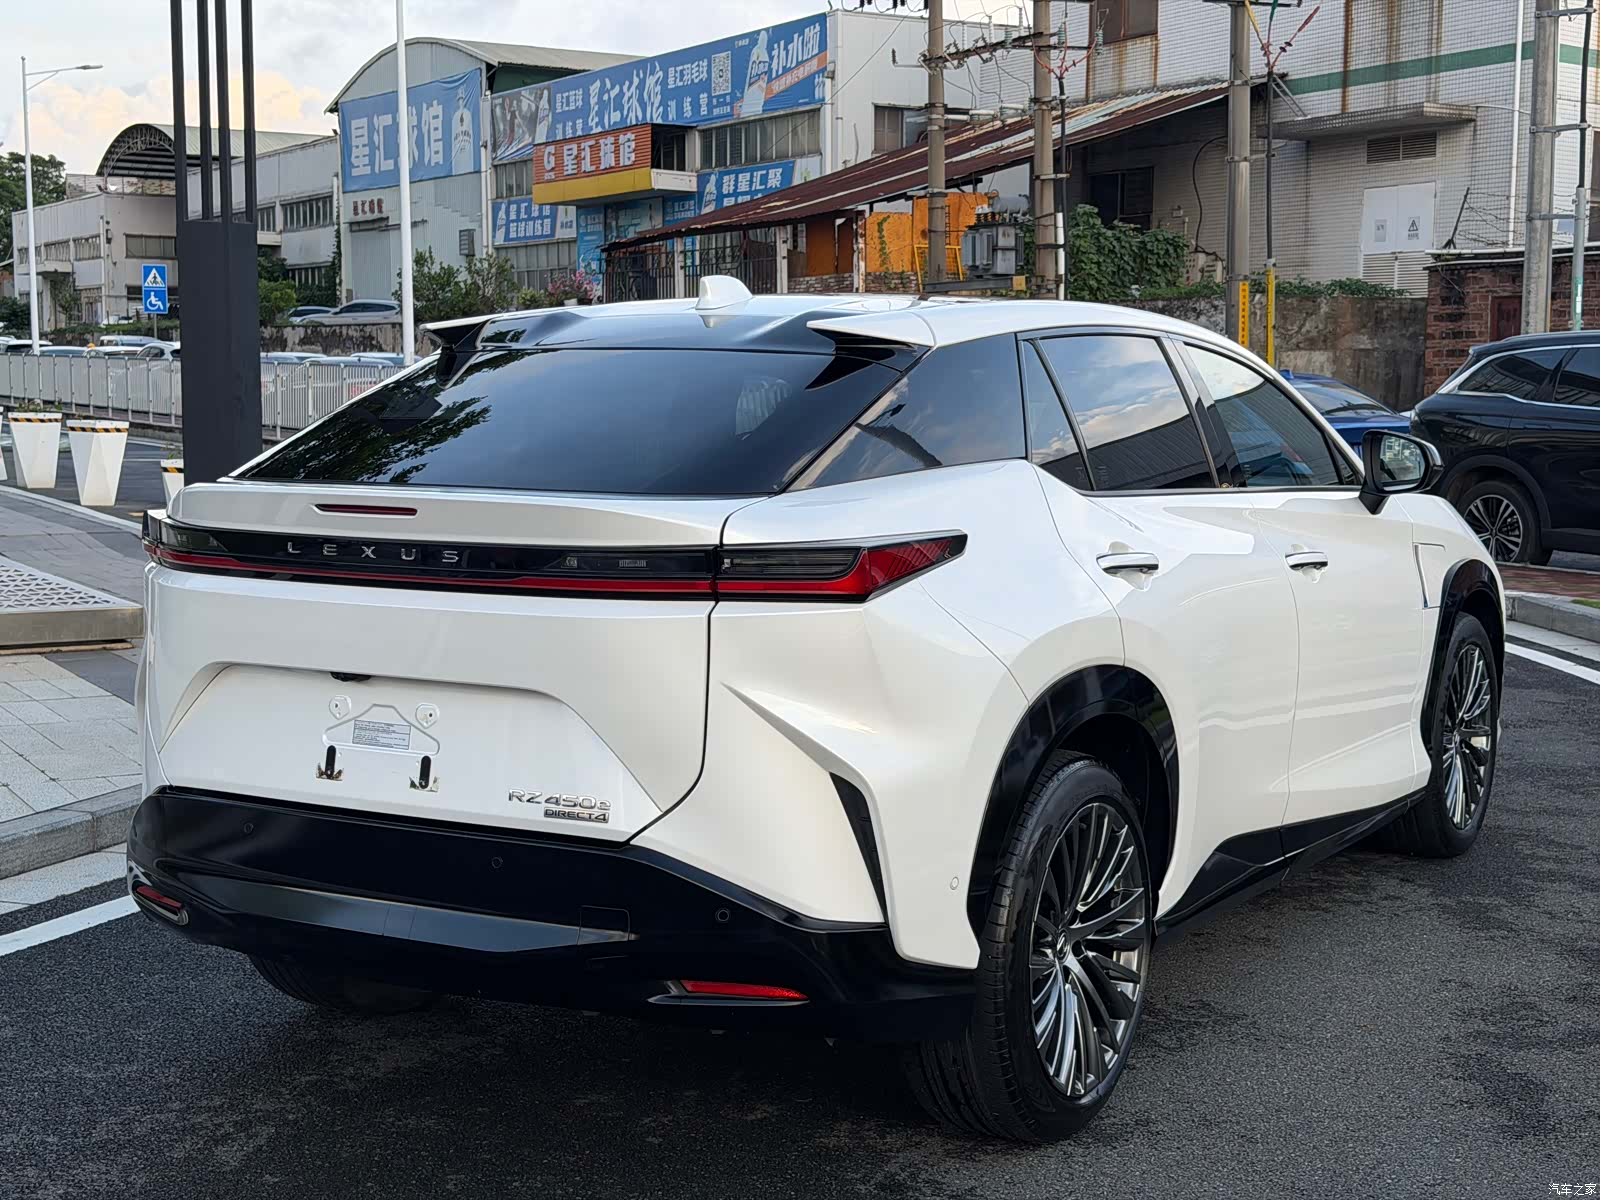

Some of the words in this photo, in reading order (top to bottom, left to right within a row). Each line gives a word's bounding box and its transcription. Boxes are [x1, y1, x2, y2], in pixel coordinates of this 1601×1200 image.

[771, 22, 821, 79] 补水啦
[667, 58, 708, 89] 星汇羽毛球
[588, 61, 664, 134] 星汇球馆
[667, 92, 708, 121] 训练营
[563, 132, 636, 176] 星汇球馆
[722, 168, 783, 195] 群星汇聚
[287, 541, 459, 563] LEXUS
[545, 808, 608, 822] DIRECT4
